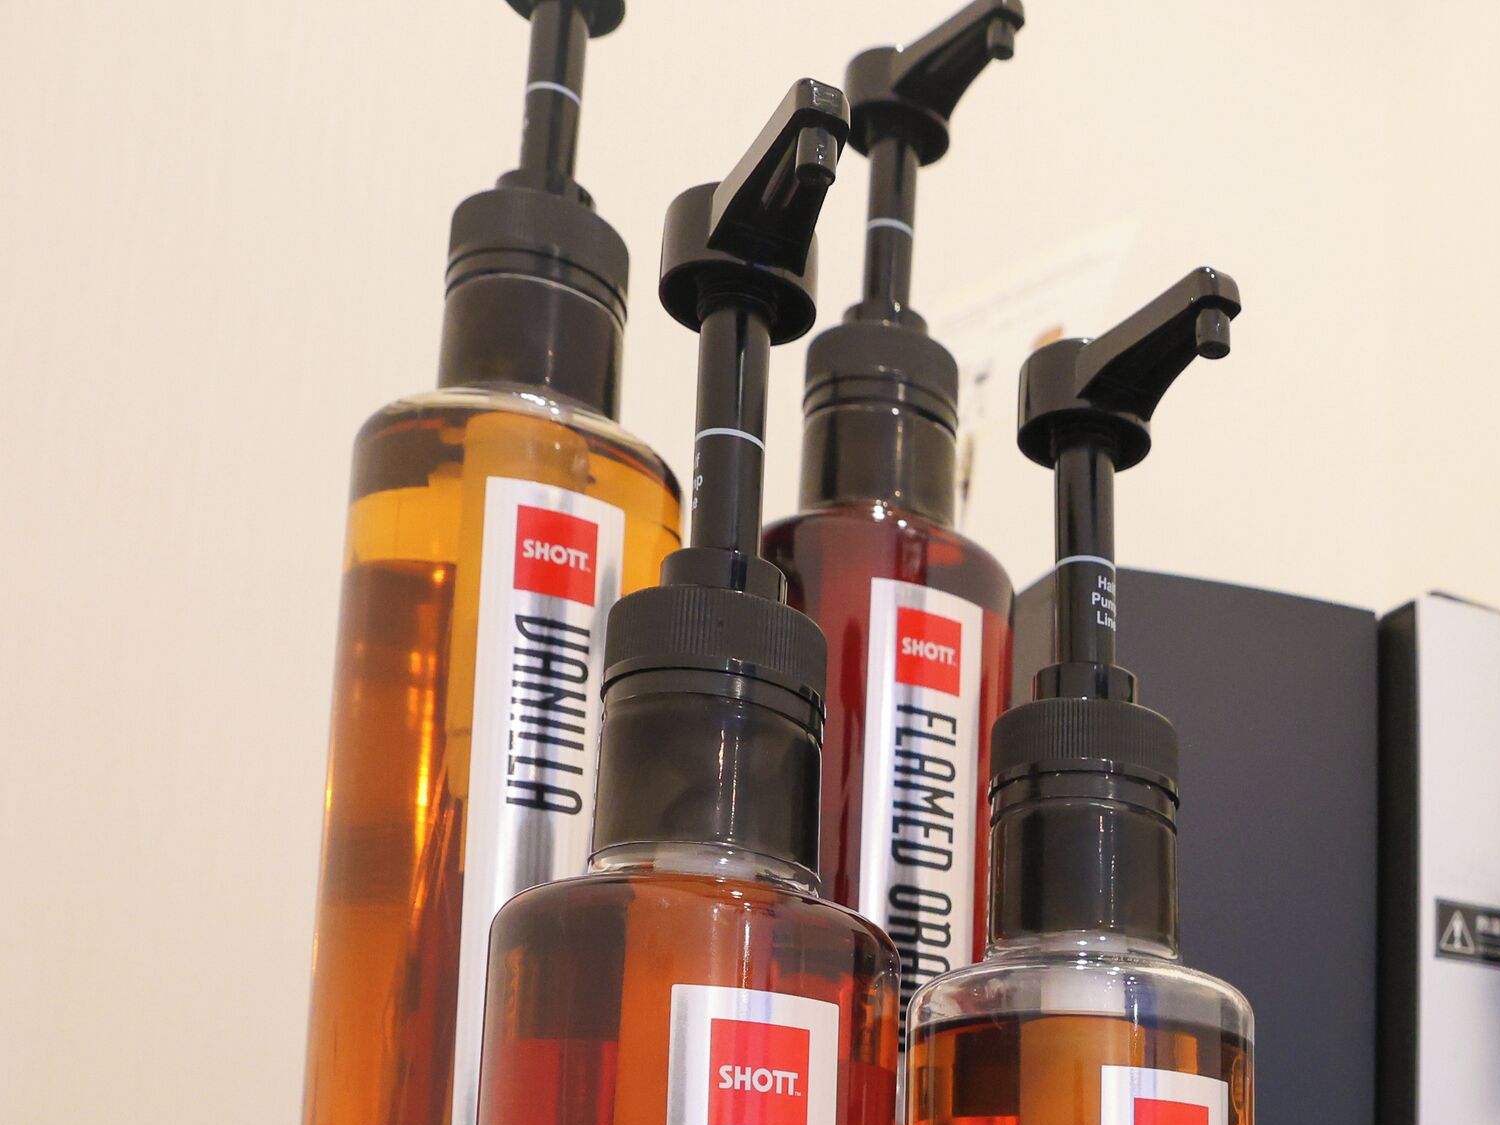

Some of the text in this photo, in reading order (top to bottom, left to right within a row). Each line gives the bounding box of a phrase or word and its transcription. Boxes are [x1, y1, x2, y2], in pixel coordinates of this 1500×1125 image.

[523, 540, 589, 571] SHOTT
[901, 636, 956, 665] SHOTT
[506, 614, 591, 815] VANILLA
[891, 703, 957, 872] FLAMED
[718, 1064, 800, 1096] SHOTT
